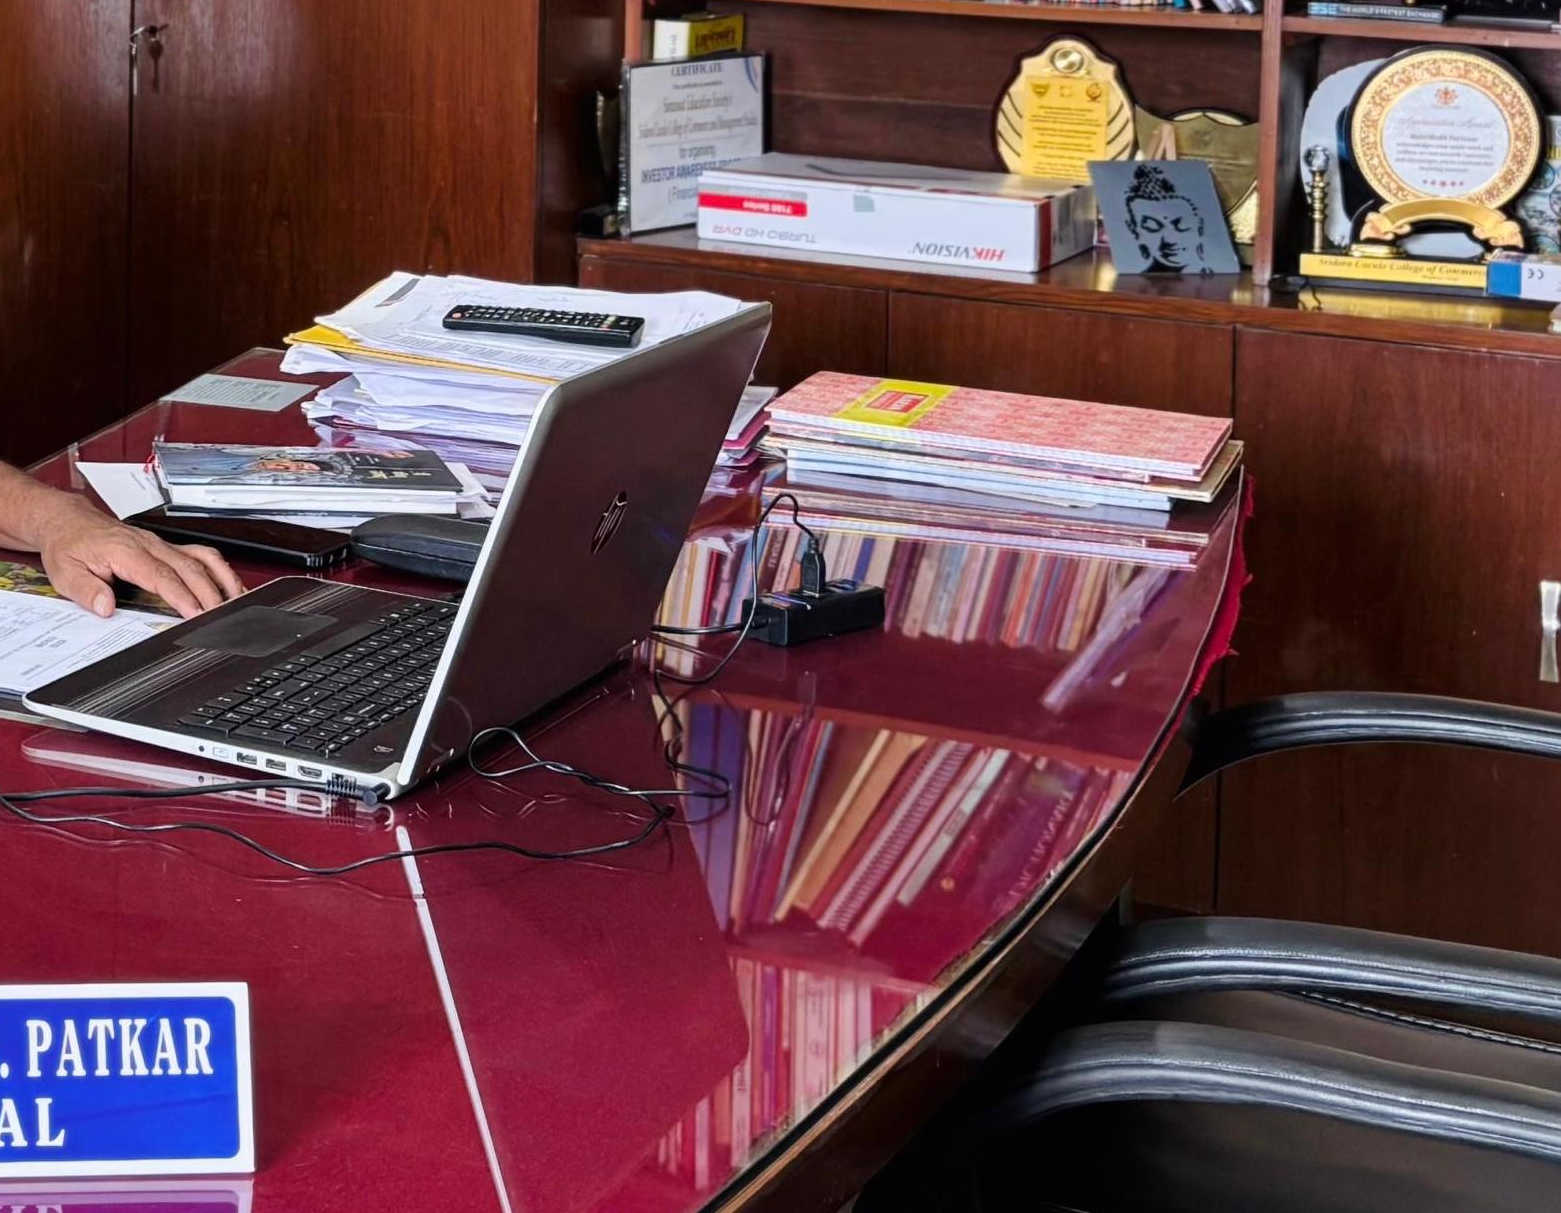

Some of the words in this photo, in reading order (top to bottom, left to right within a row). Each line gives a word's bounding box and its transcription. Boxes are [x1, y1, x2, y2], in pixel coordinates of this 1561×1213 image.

[670, 62, 724, 78] CERTIFICATE
[711, 224, 743, 237] DVR
[744, 228, 764, 239] HD
[766, 230, 818, 244] TURBO
[911, 240, 1006, 263] HIKVISION
[26, 1017, 214, 1079] PATKAR
